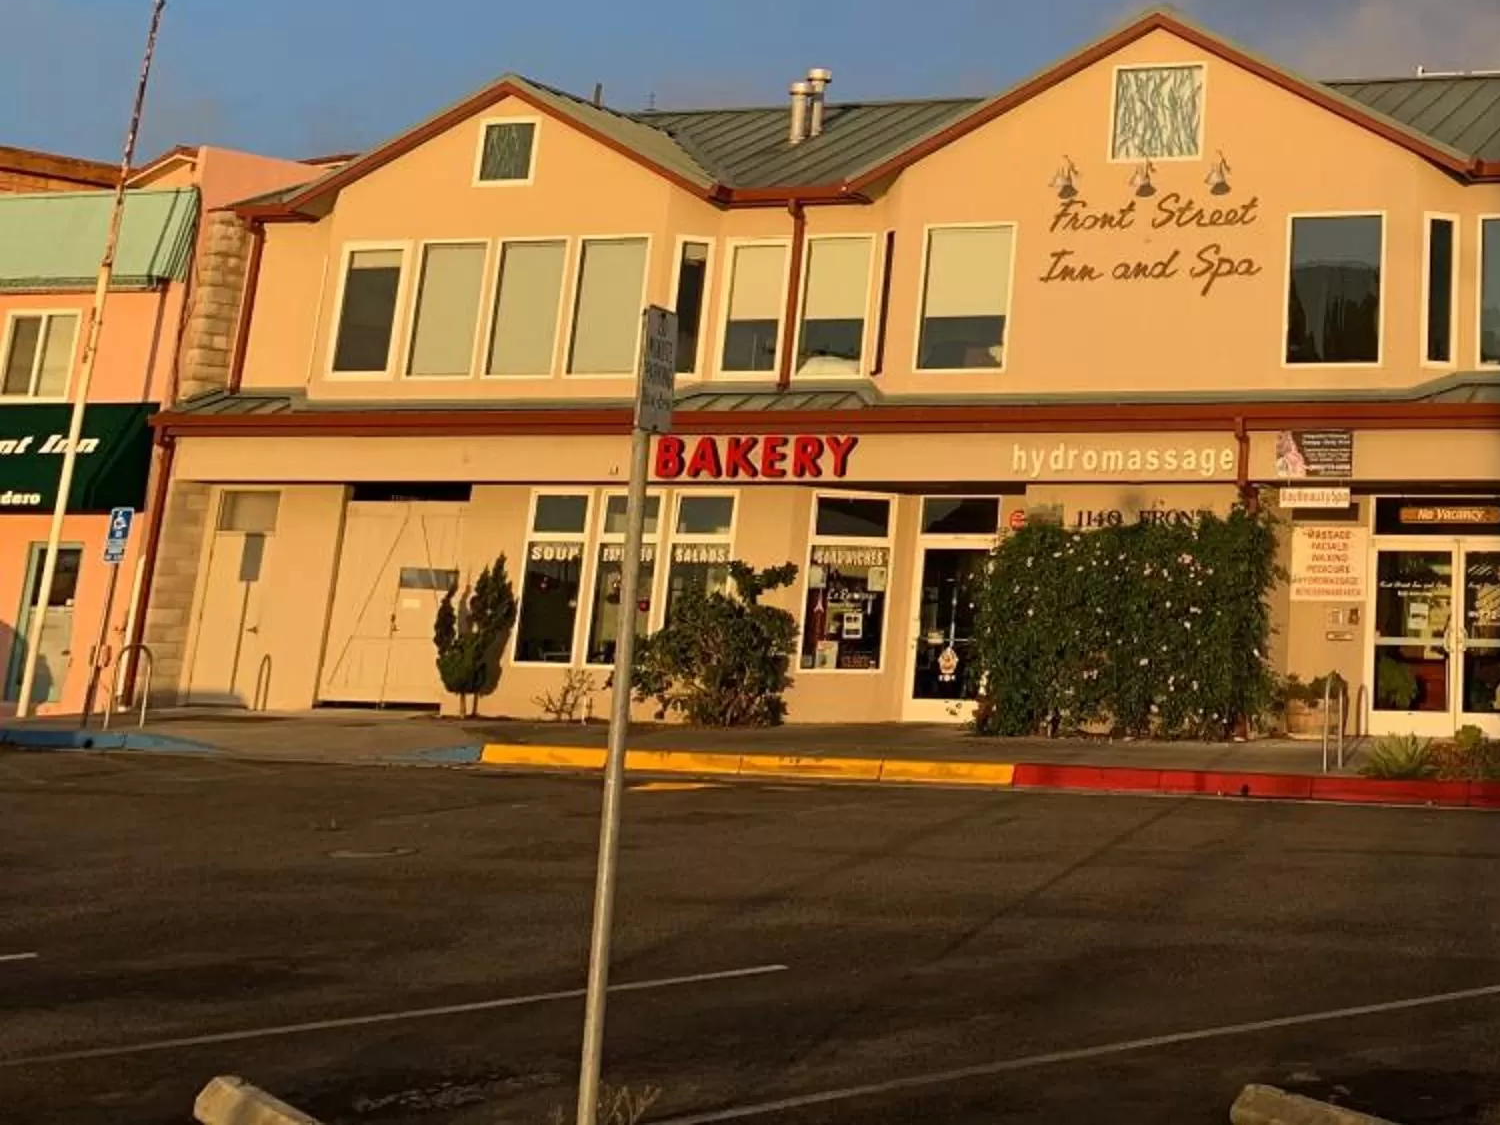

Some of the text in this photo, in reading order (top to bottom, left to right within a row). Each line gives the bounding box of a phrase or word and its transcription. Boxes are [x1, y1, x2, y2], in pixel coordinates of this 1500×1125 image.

[1049, 192, 1259, 232] Front Street
[1039, 243, 1262, 297] Inn and Spa
[37, 434, 100, 454] Inn
[655, 435, 859, 480] BAKERY
[1012, 443, 1236, 479] hydromassage
[1077, 509, 1124, 527] 1140
[531, 545, 580, 561] SOUP
[675, 547, 725, 564] SALADS
